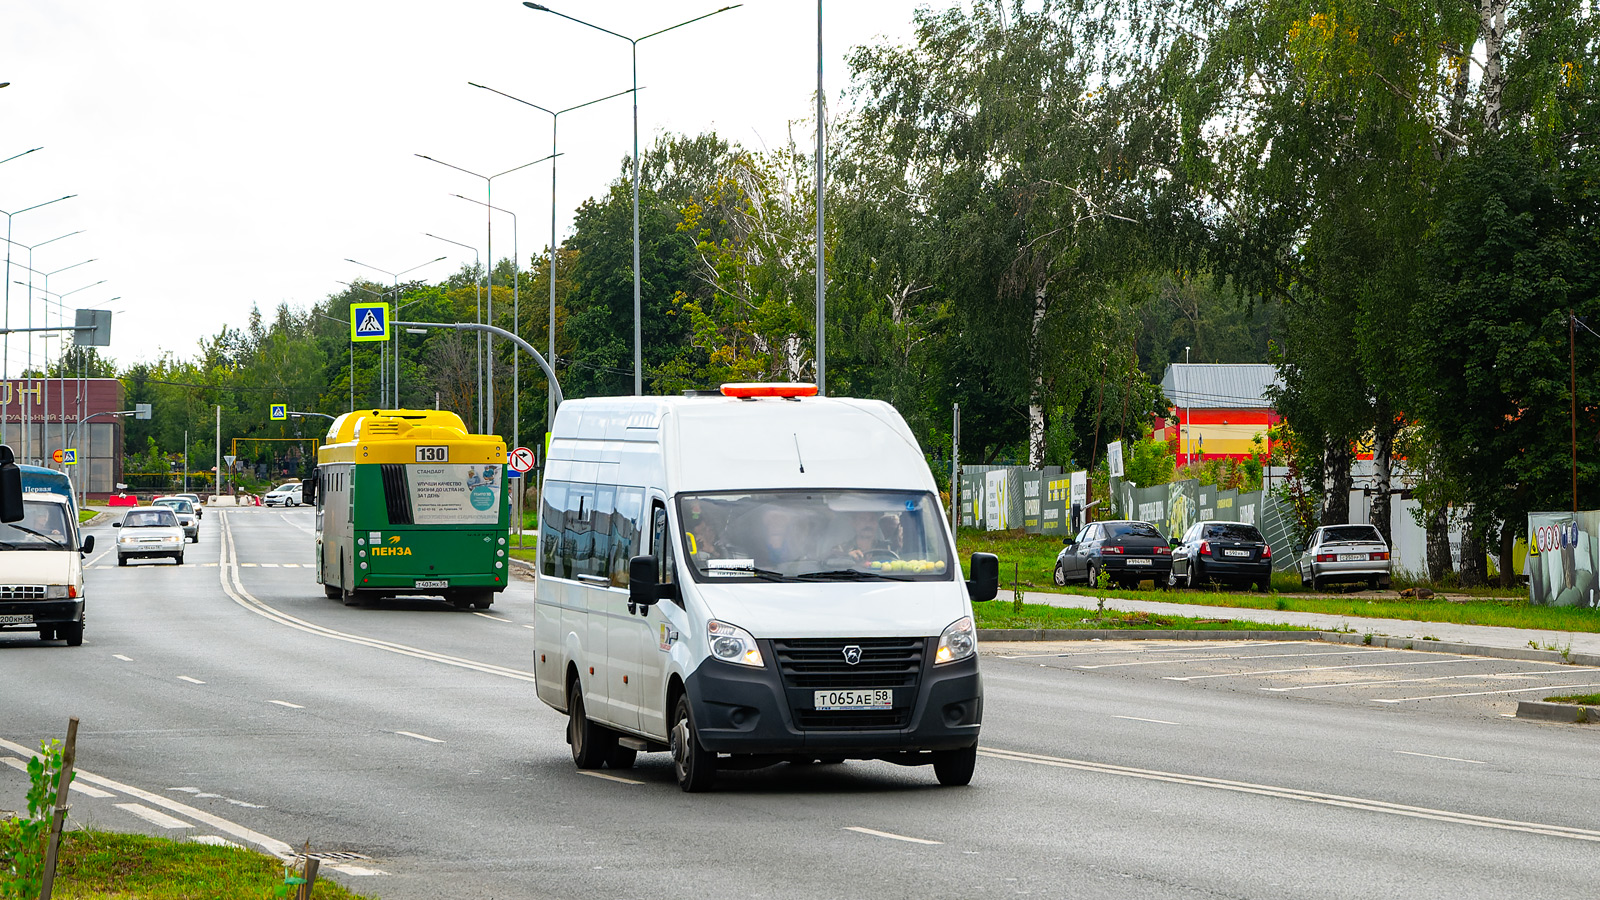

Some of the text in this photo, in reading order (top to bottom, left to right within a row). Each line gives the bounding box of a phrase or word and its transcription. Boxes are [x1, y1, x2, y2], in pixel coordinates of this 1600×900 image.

[418, 448, 445, 460] 130
[372, 546, 412, 556] ПЕНЗА
[820, 691, 888, 705] Т065АЕ 58
